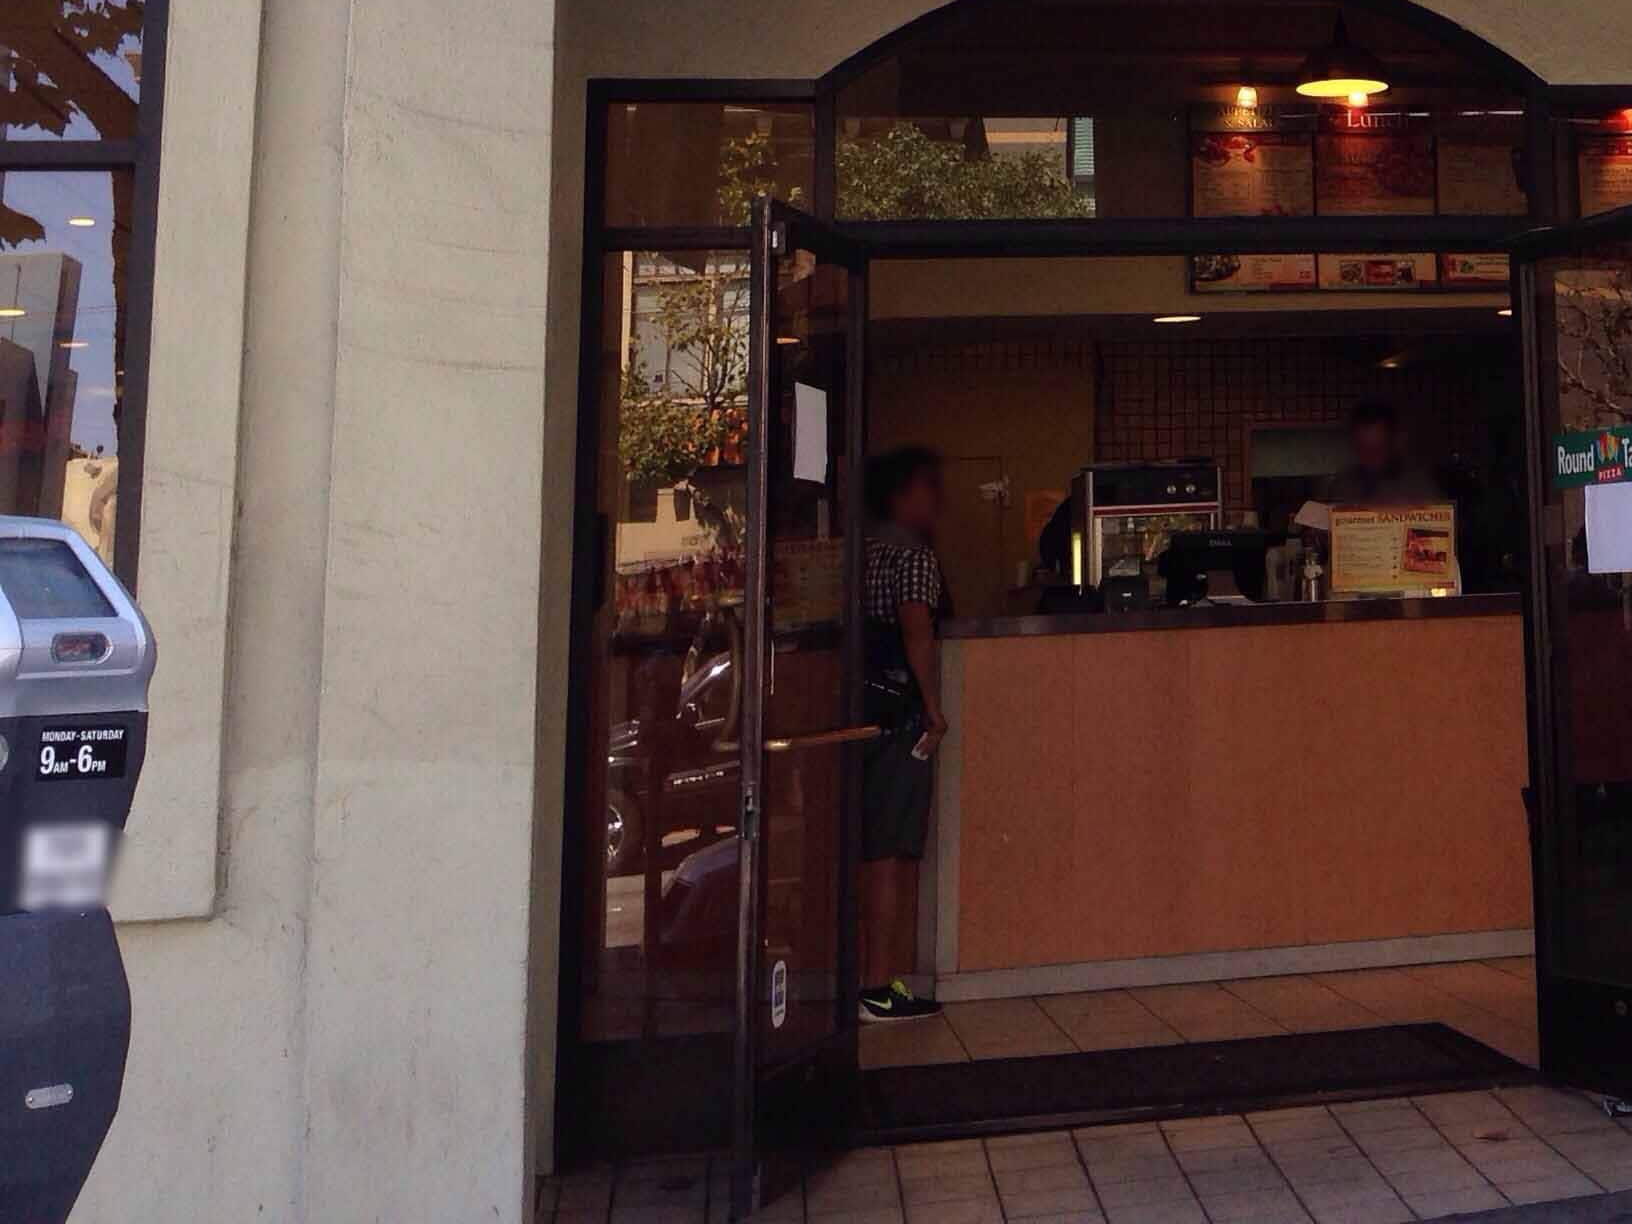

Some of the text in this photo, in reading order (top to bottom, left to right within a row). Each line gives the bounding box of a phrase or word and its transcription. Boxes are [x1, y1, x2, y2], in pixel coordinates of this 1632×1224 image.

[1557, 444, 1595, 475] Round
[1598, 467, 1622, 480] PIZZA
[42, 729, 124, 742] MONDAY-SATURDAY
